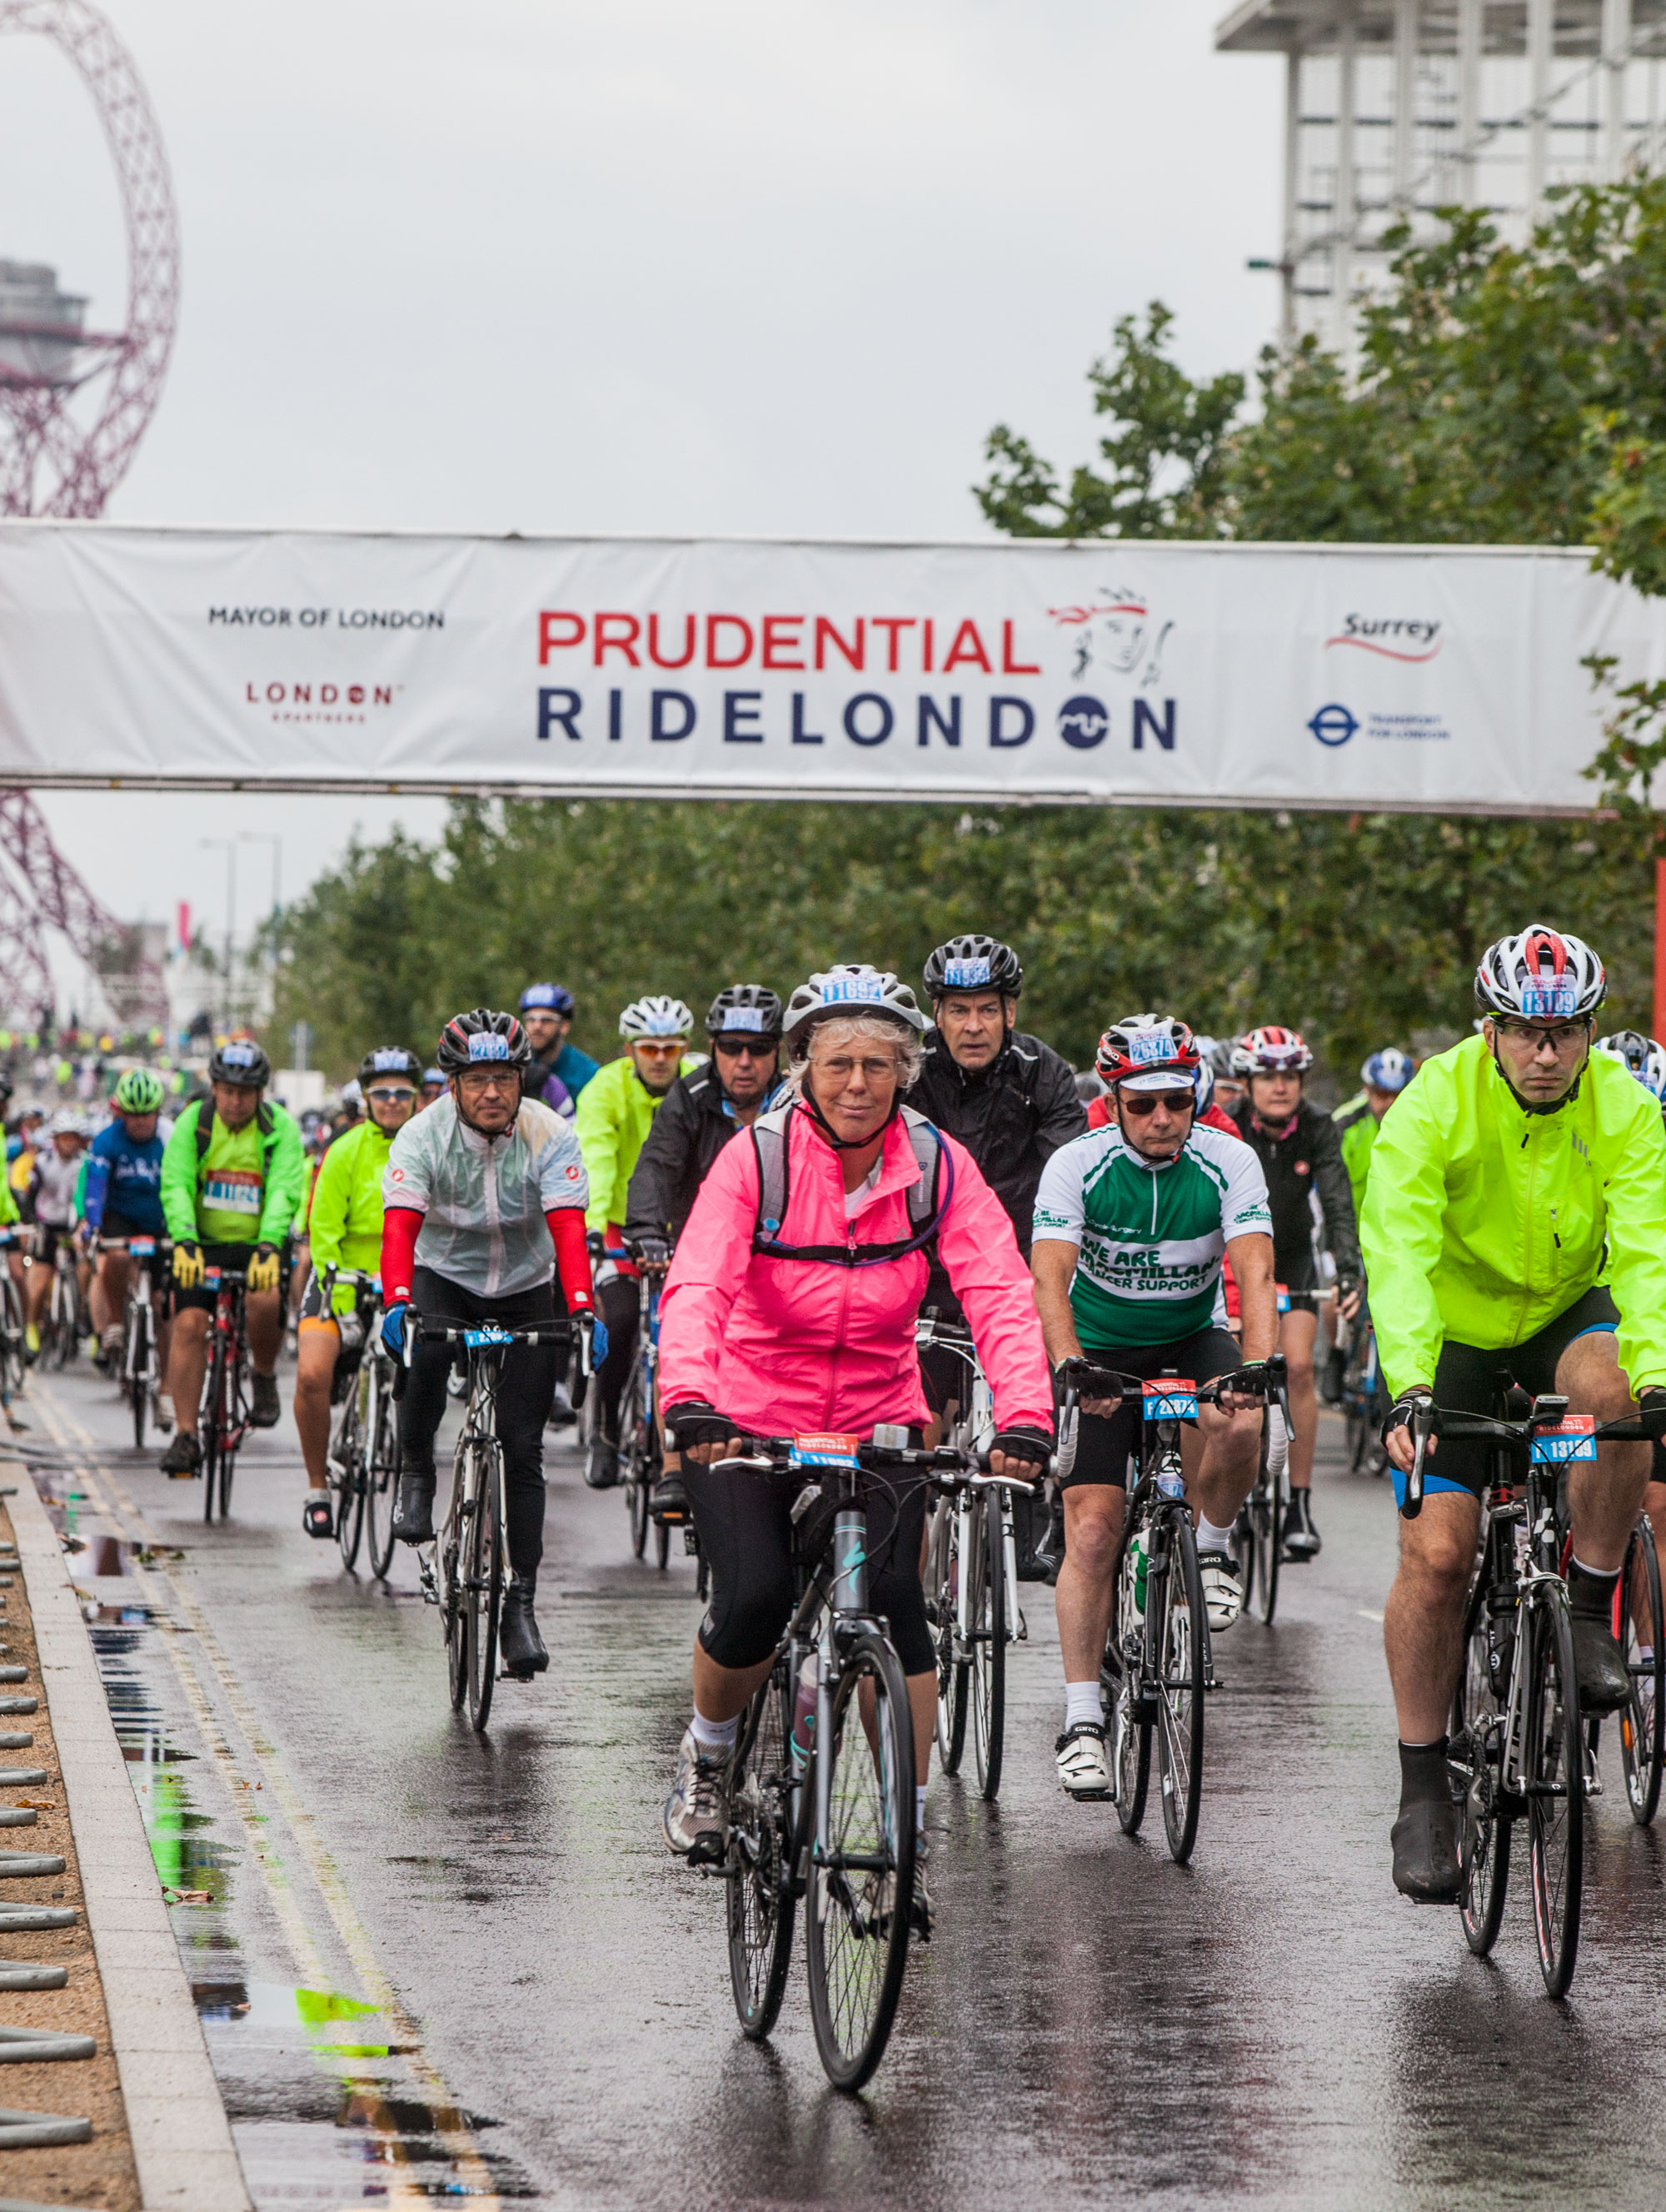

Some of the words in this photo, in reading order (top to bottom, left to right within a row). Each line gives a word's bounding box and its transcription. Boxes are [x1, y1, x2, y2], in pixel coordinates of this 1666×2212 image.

[209, 606, 291, 626] MAYOR
[298, 608, 331, 626] OF
[338, 609, 445, 628] LONDON
[1342, 613, 1442, 643] Surrey
[537, 610, 1041, 675] PRUDENTIAL
[247, 681, 392, 705] LONDON
[536, 687, 1176, 750] RIDELONDON
[826, 981, 880, 1002] 11692
[1524, 991, 1574, 1012] 13109
[1134, 1039, 1175, 1062] 26874
[1081, 1235, 1110, 1263] WE
[1115, 1250, 1161, 1268] ARE
[1088, 1265, 1132, 1289] ANCER
[1137, 1275, 1208, 1291] SUPPORT
[1147, 1402, 1154, 1416] F
[1550, 1440, 1593, 1457] 13109
[1075, 1726, 1099, 1734] GIRO
